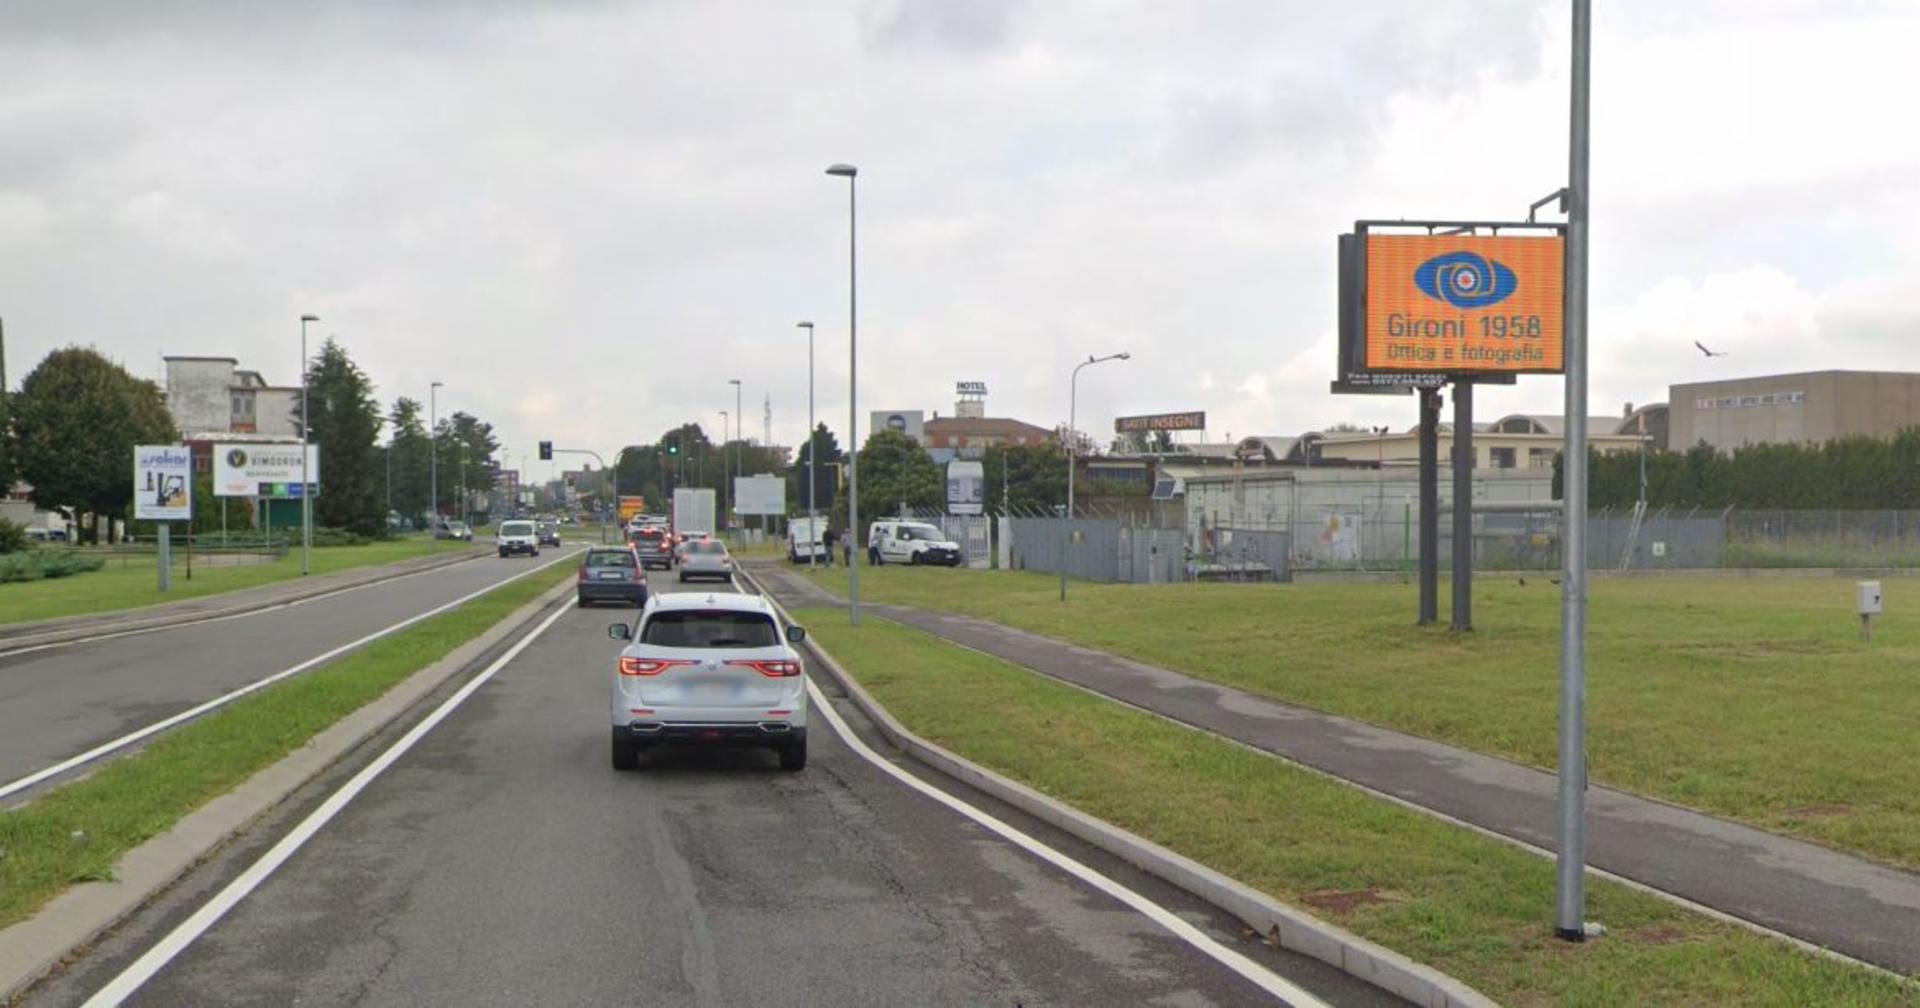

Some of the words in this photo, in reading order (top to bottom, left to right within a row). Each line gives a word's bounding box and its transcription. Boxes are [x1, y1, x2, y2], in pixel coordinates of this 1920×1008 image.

[1388, 313, 1465, 338] Gironi
[1480, 314, 1541, 338] 1958
[1388, 343, 1436, 360] Ottica
[1444, 347, 1454, 360] e
[1462, 342, 1545, 365] fotografia
[956, 381, 986, 391] HOTEL
[1150, 415, 1202, 429] INSEGNE
